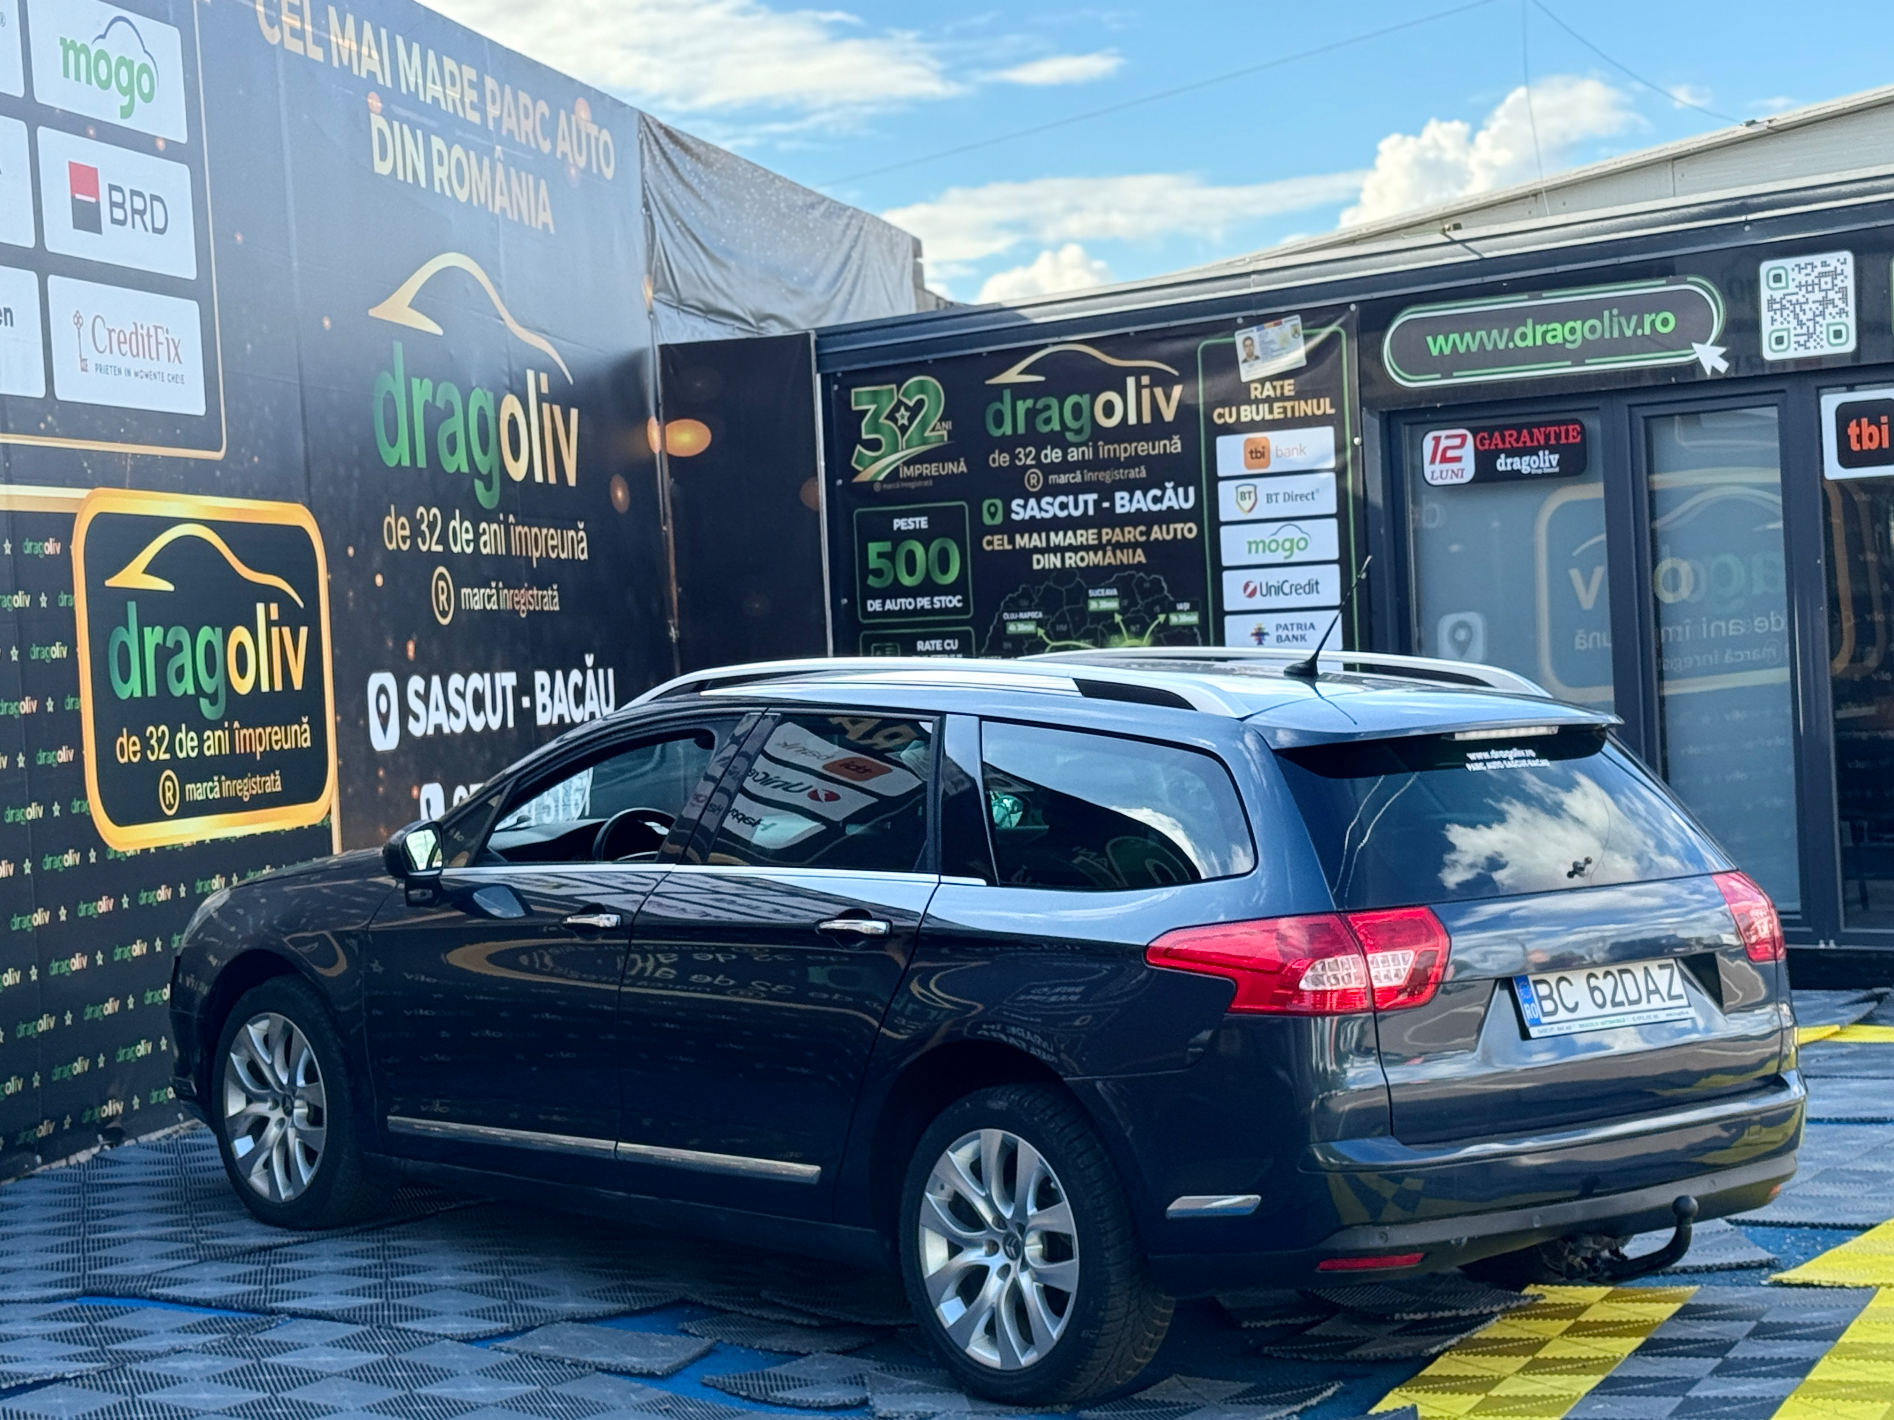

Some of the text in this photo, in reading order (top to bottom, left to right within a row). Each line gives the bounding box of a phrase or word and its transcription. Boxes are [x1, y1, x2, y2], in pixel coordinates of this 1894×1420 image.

[59, 36, 155, 119] mogo
[255, 0, 615, 180] CEL MAI MARE PARC AUTO
[370, 113, 555, 234] DIN ROMÂNIA
[108, 182, 169, 235] BRD
[91, 314, 183, 364] CreditFix
[1426, 308, 1676, 357] www.dragoliv.ro
[1250, 379, 1295, 399] RATE
[985, 375, 1184, 443] dragoliv
[1213, 397, 1335, 425] CU BULETINUL
[373, 340, 578, 509] dragoliv
[851, 375, 948, 471] 32
[1847, 414, 1889, 451] tbi
[1429, 433, 1467, 465] 12
[1475, 424, 1581, 450] GARANTIE
[989, 435, 1182, 468] de 32 de ani împreună
[1248, 444, 1306, 460] tbi bank
[1496, 450, 1559, 474] dragoliv
[1049, 469, 1082, 486] marcă
[1083, 467, 1147, 486] înregistrată
[1430, 468, 1465, 481] LUNI
[1010, 494, 1098, 521] SASCUT
[1114, 481, 1195, 514] BACĂU
[1240, 491, 1252, 501] BT
[1266, 493, 1281, 505] BT
[383, 504, 588, 568] de 32 de ani împreună
[893, 517, 928, 531] PESTE
[23, 537, 61, 559] dragoliv
[982, 523, 1197, 551] CEL MAI MARE PARC AUTO
[1247, 536, 1308, 560] mogo
[867, 537, 960, 588] 500
[1032, 544, 1146, 570] DIN ROMÂNIA
[460, 581, 498, 611] marcă
[499, 581, 560, 618] înregistrată
[1259, 578, 1320, 597] UniCredit
[867, 595, 963, 611] DE AUTO PE STOC
[1276, 621, 1315, 633] PATRIA
[1276, 633, 1307, 644] BANK
[30, 642, 67, 663] dragoliv
[917, 639, 958, 651] RATE CU
[108, 601, 308, 720] dragoliv
[407, 671, 517, 738] SASCUT
[534, 653, 615, 727] BACĂU
[115, 716, 311, 764] de 32 de ani împreună
[36, 746, 74, 767] dragoliv
[186, 776, 221, 802] marcă
[221, 770, 282, 801] înregistrată
[4, 802, 44, 823] dragoliv
[42, 849, 80, 872] dragoliv
[77, 896, 114, 918] dragoliv
[138, 885, 172, 906] dragoliv
[10, 908, 50, 931] dragoliv
[113, 940, 147, 961] dragoliv
[50, 953, 88, 976] dragoliv
[1532, 963, 1684, 1017] BC 62DAZ
[83, 997, 120, 1021] dragoliv
[1524, 1002, 1538, 1021] RO
[16, 1014, 55, 1038] dragoliv
[115, 1040, 152, 1062] dragoliv
[52, 1057, 90, 1081] dragoliv
